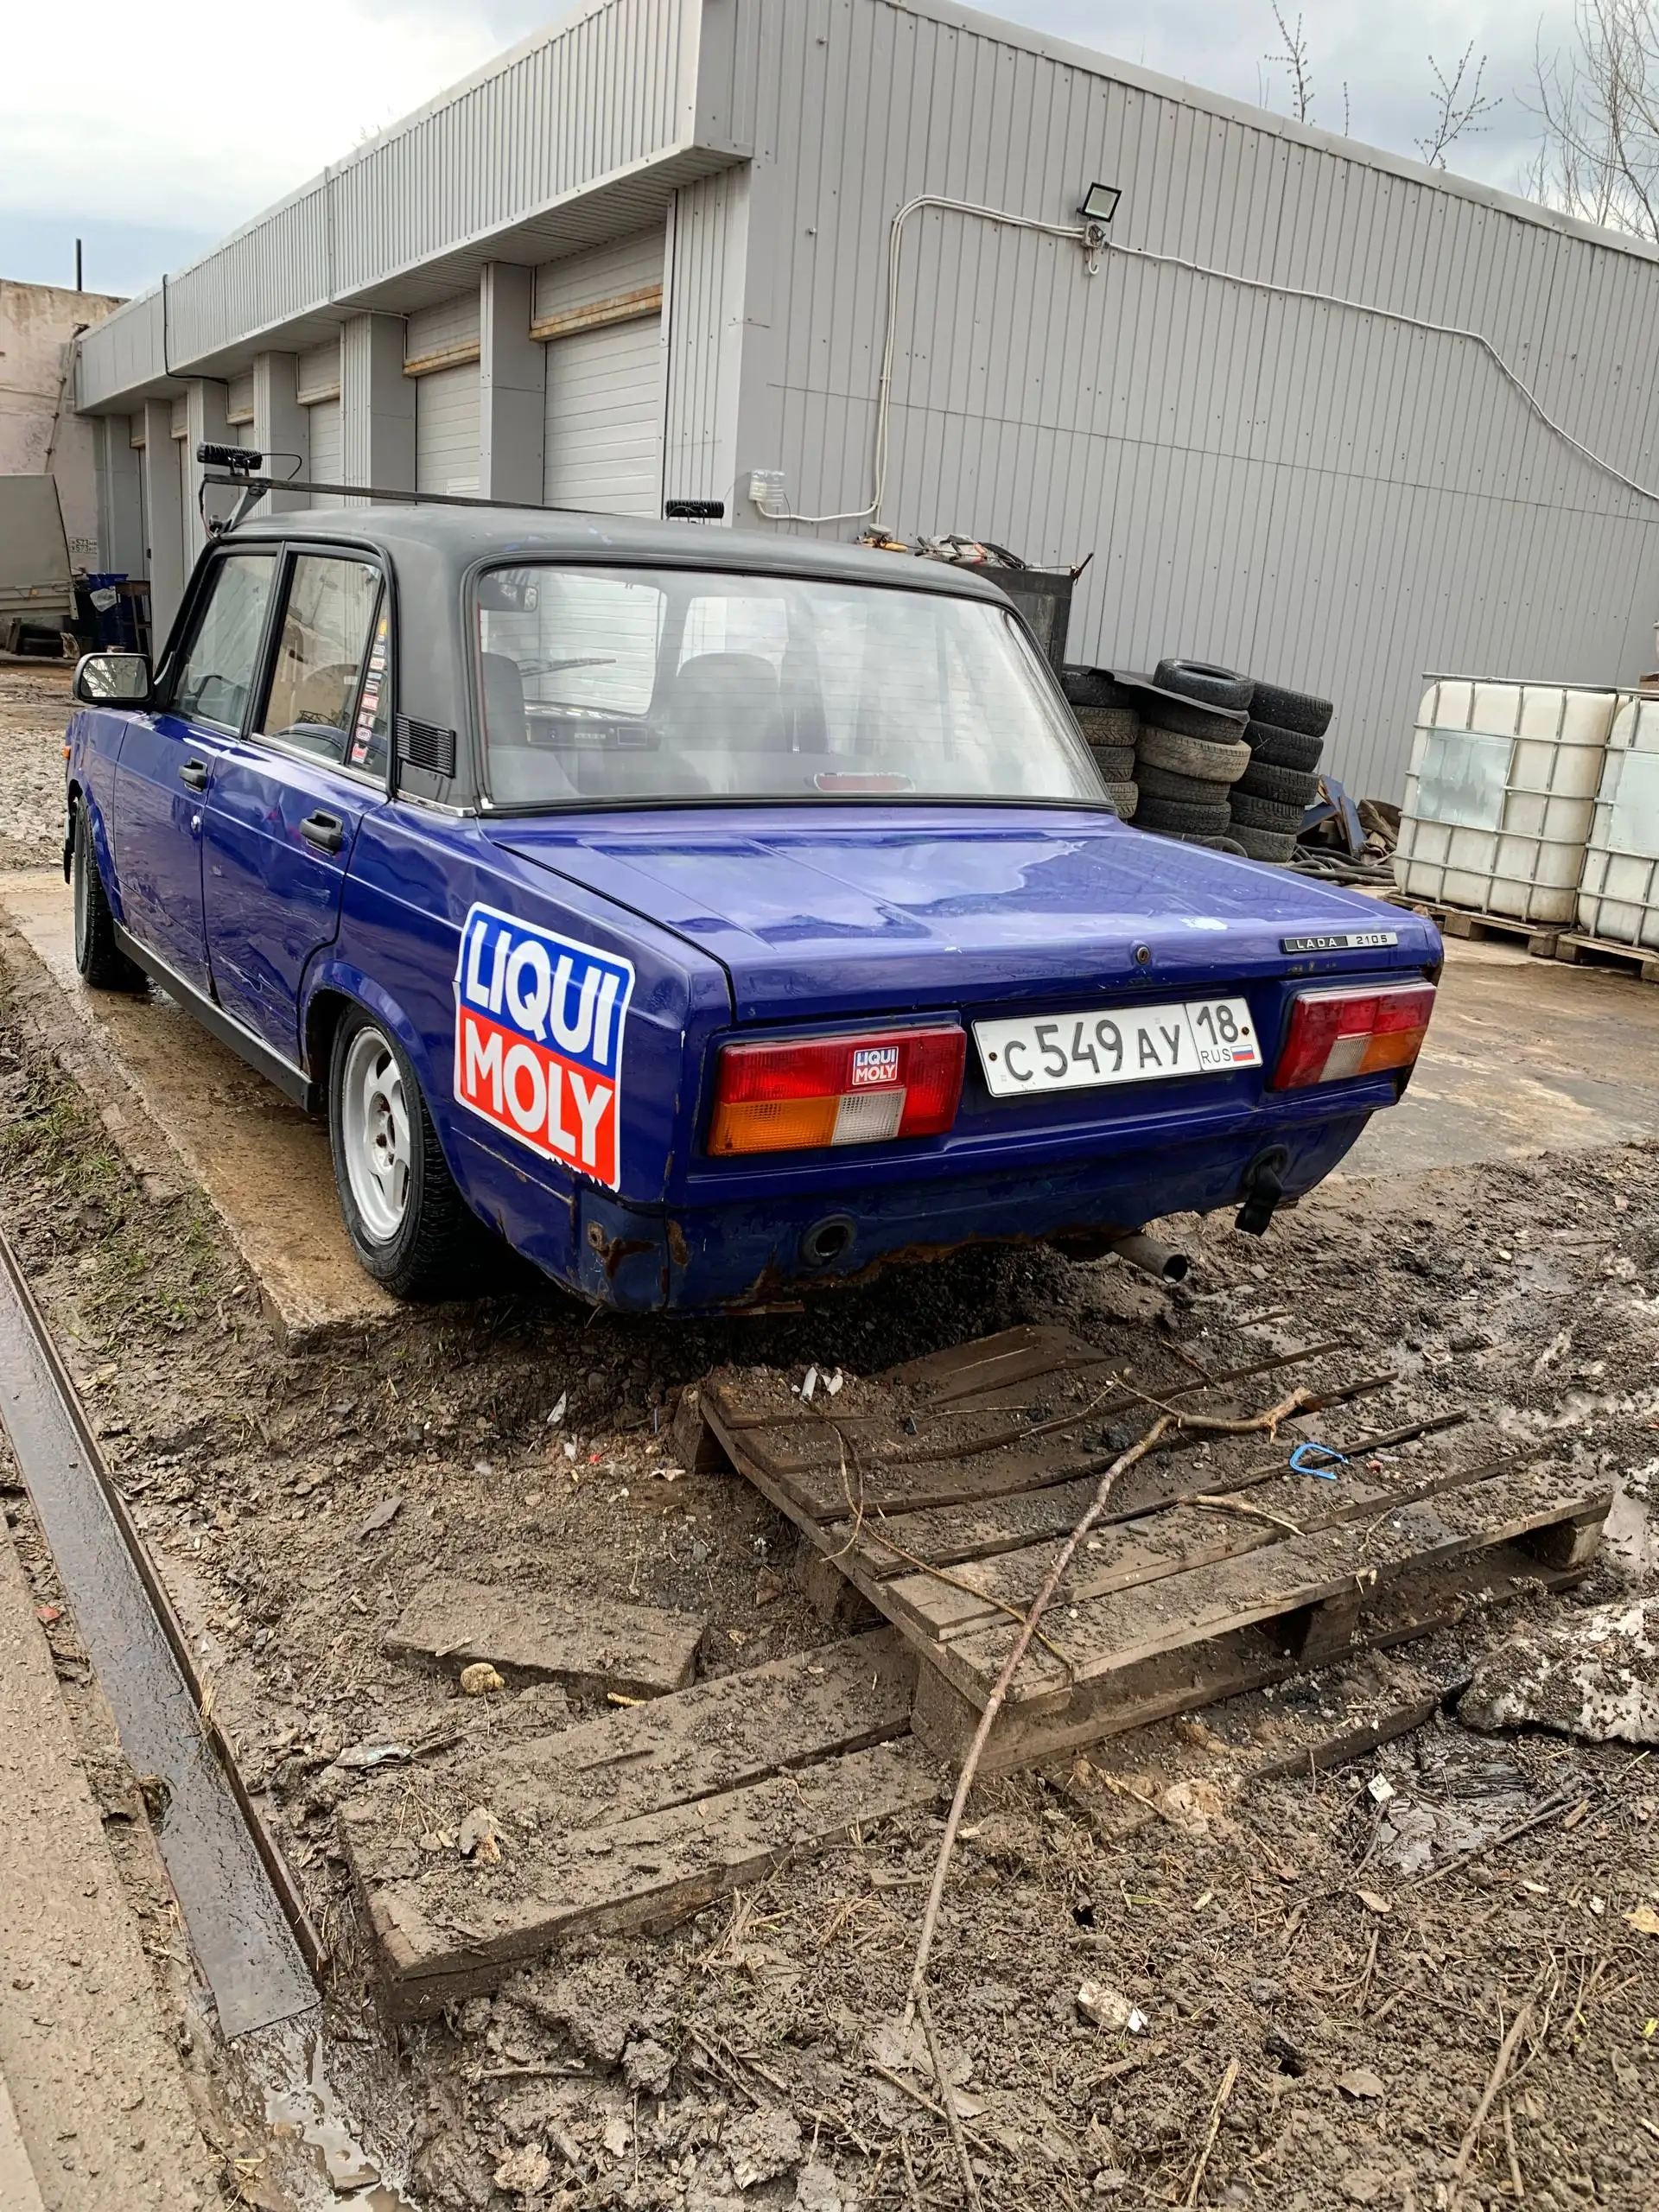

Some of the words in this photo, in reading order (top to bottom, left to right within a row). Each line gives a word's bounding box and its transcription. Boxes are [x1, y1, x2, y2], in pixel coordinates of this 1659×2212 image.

[1296, 938, 1338, 949] LADA
[1356, 934, 1388, 944] 2105
[466, 920, 620, 1066] LIQUI
[1197, 1004, 1239, 1045] 18
[856, 1048, 896, 1067] LIQUI
[1199, 1046, 1231, 1065] RUS
[855, 1064, 896, 1083] MOLY
[465, 1017, 613, 1167] MOLY
